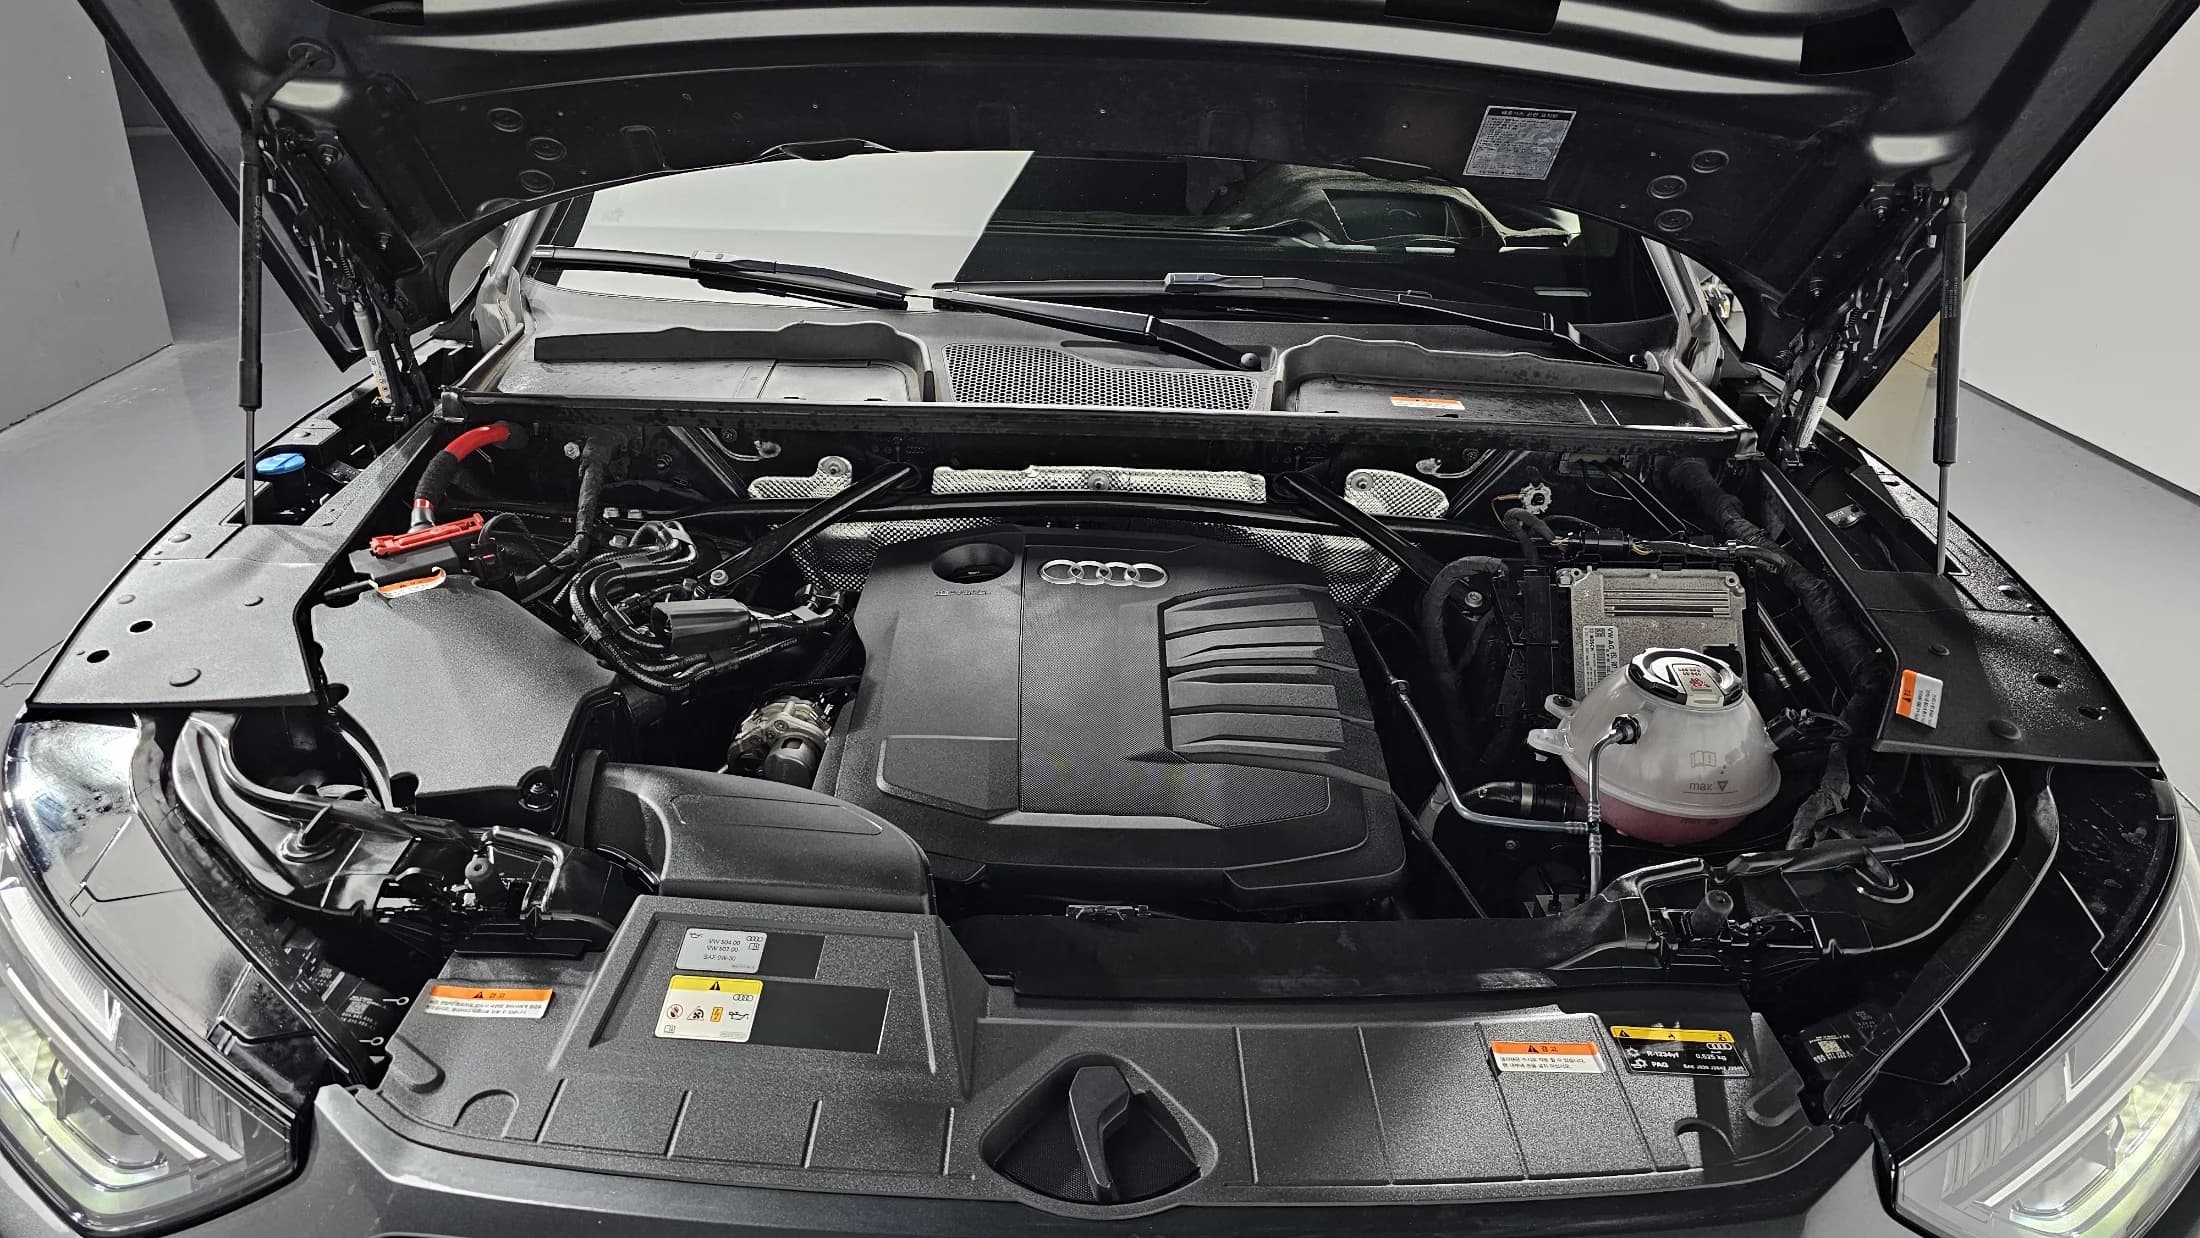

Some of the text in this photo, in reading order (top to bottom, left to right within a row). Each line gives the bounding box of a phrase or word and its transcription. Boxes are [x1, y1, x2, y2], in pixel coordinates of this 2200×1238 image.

[1607, 627, 1614, 639] VW
[1608, 640, 1615, 650] AG
[1688, 782, 1713, 791] max
